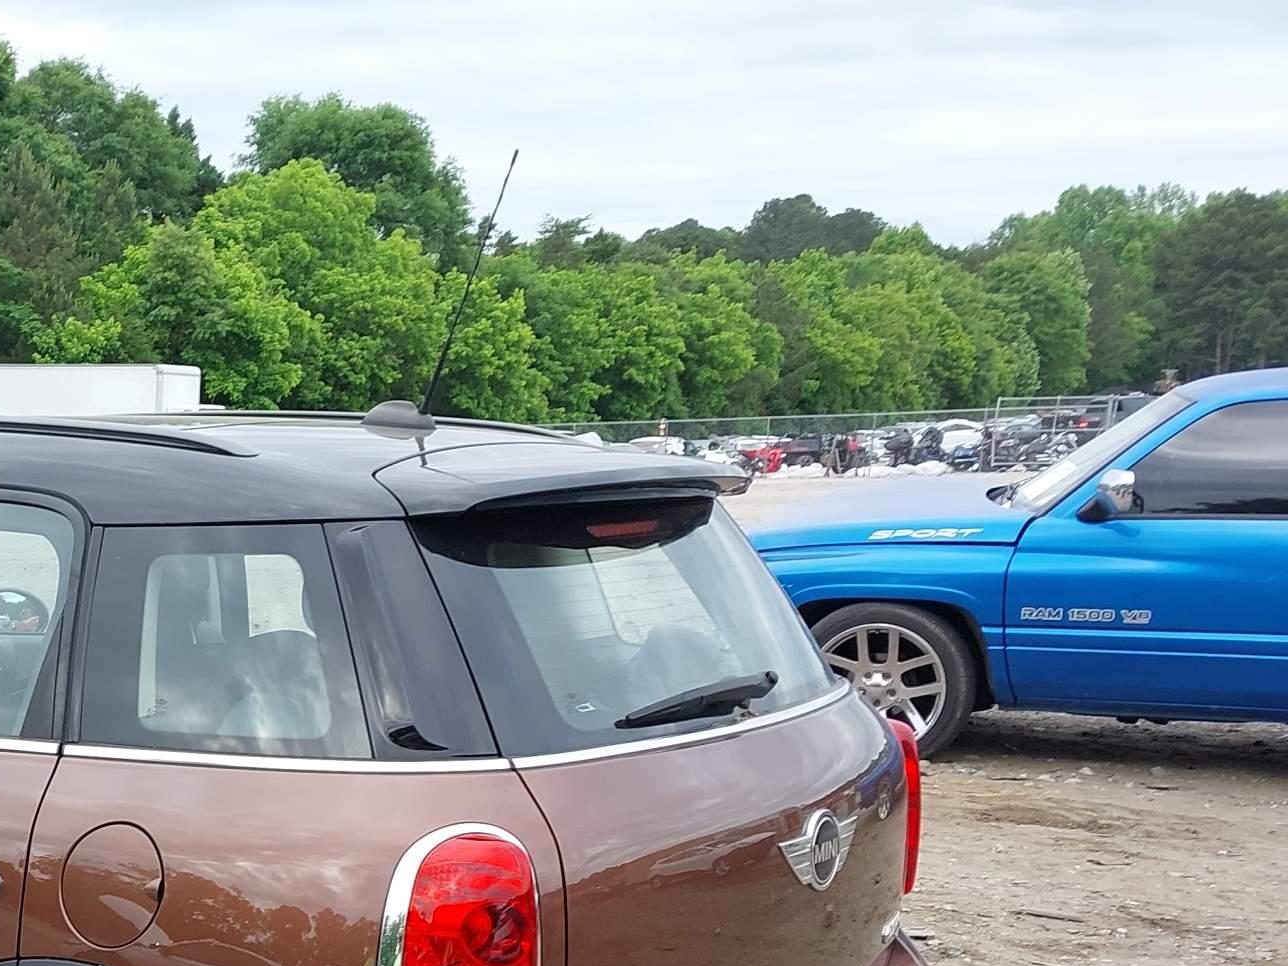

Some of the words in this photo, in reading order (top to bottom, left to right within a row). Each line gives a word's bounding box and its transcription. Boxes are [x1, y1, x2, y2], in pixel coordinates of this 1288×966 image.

[868, 527, 985, 540] SPORT
[1020, 607, 1064, 621] RAM
[1067, 608, 1116, 622] 1500
[814, 837, 839, 865] MINI
